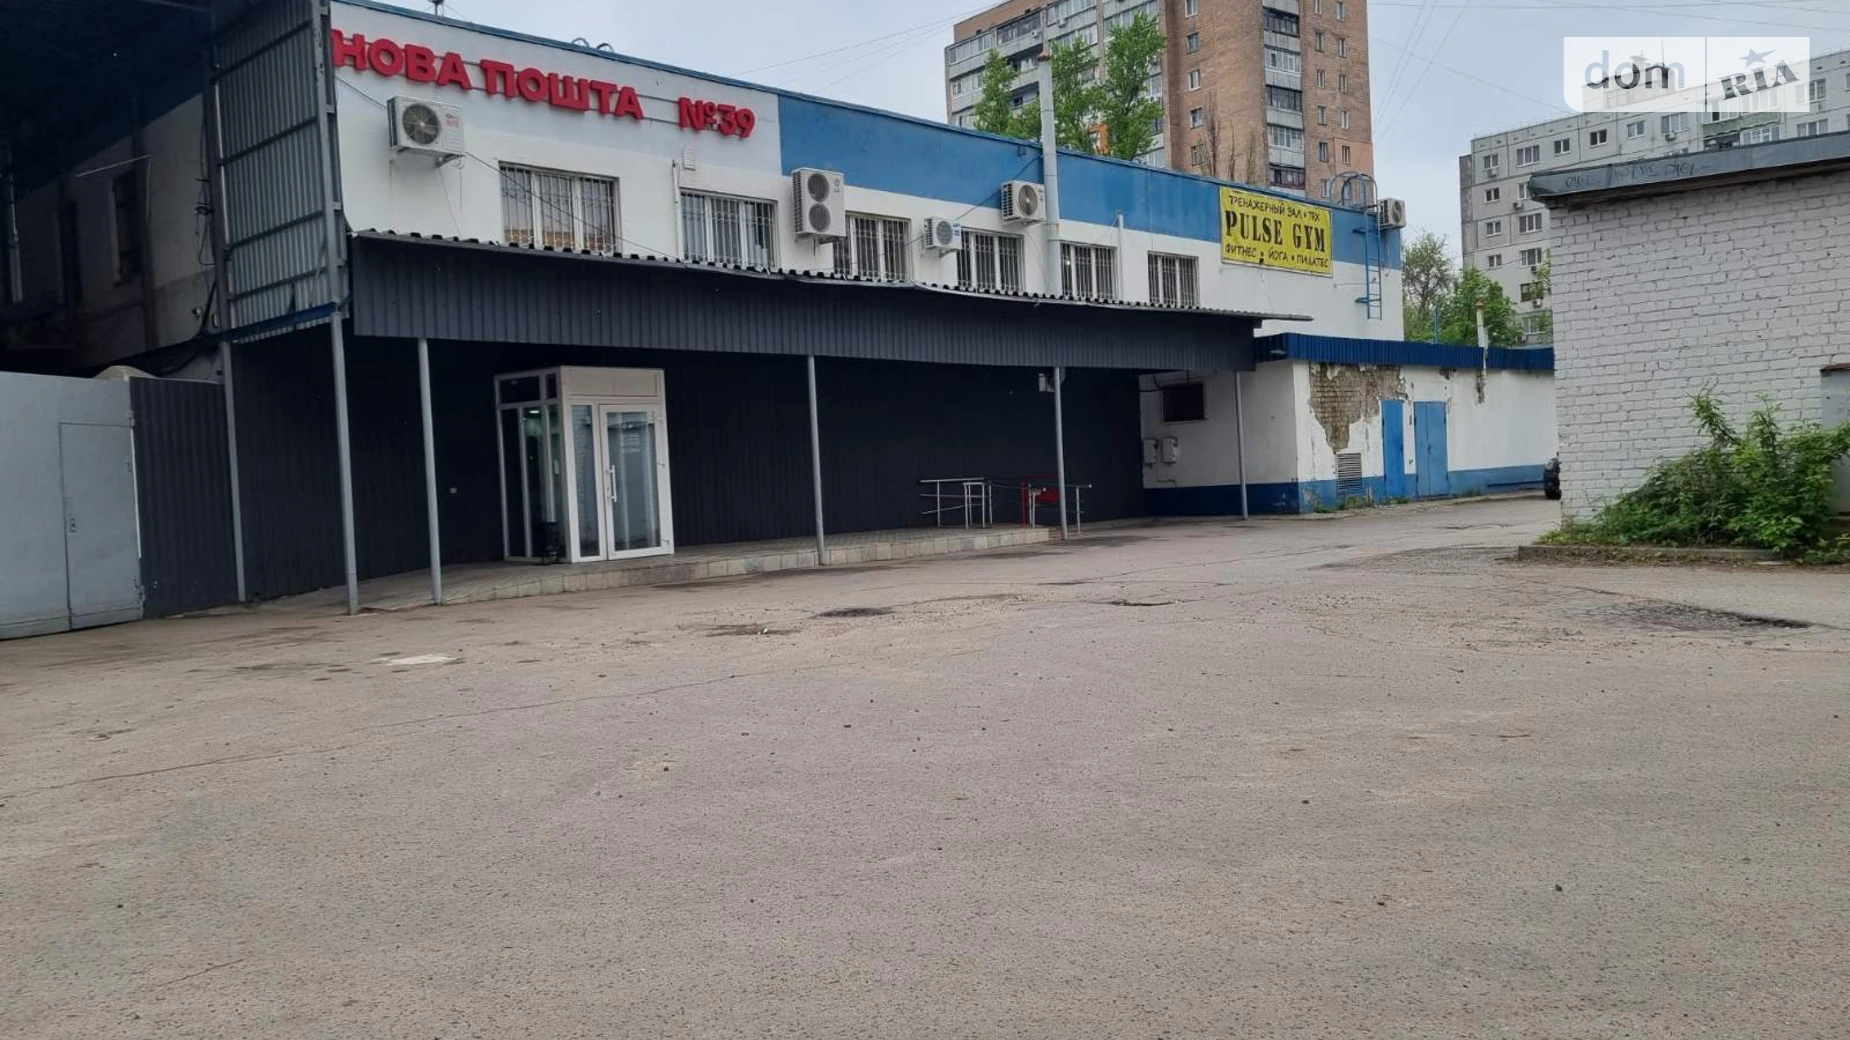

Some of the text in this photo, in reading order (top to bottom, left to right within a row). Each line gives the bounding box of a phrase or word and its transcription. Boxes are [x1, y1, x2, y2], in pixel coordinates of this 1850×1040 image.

[331, 29, 756, 138] НОВА ПОШТА №39
[1229, 195, 1285, 216] ТРЕНАЖЕРНЫЙ
[1288, 207, 1302, 219] ЗАЛ
[1225, 210, 1325, 252] PULSE GYM
[1226, 243, 1328, 268] ФИТНЕС ЙОГА ПИЛАТЕС
